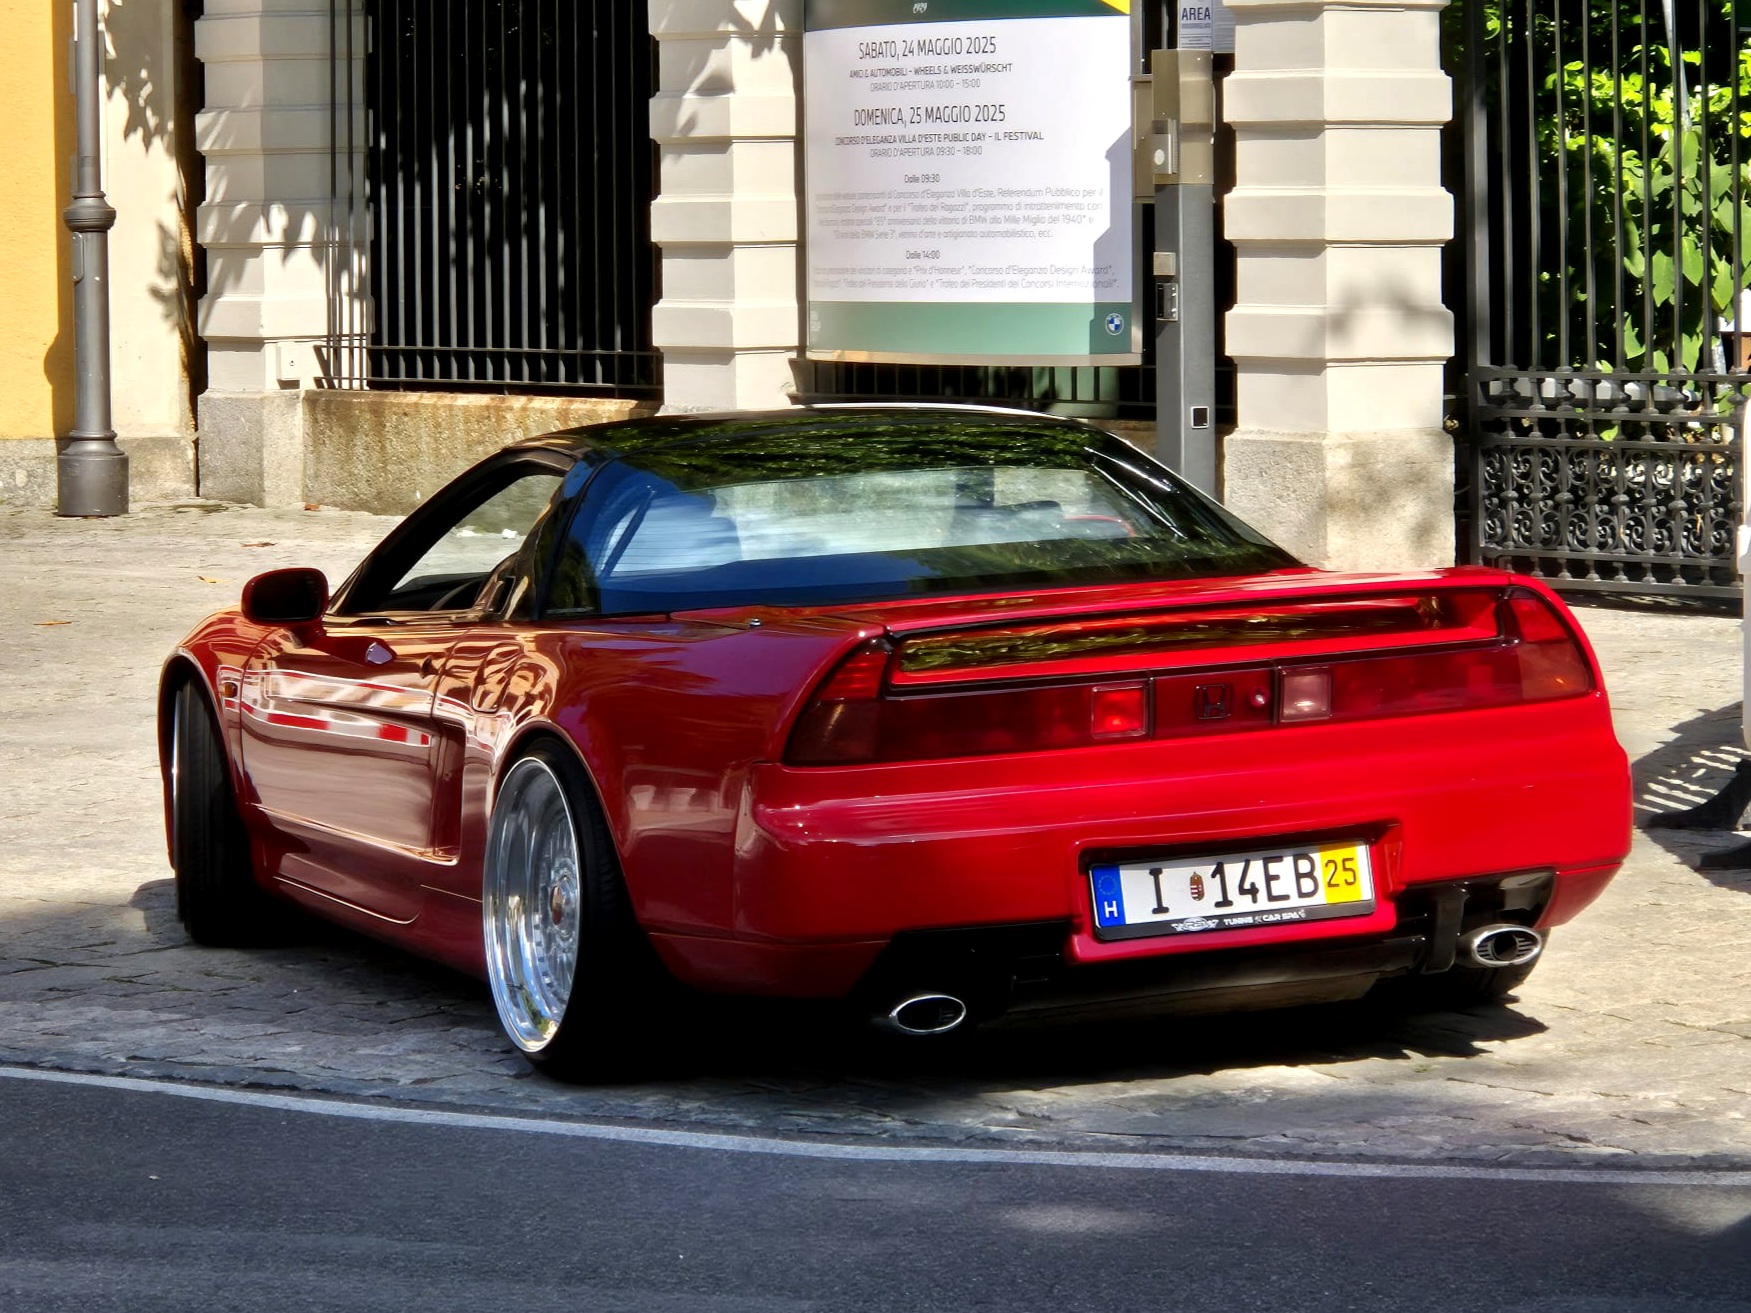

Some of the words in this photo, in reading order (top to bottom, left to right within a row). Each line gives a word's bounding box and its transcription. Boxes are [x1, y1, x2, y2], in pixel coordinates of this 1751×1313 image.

[1181, 7, 1211, 20] AREA
[859, 41, 900, 60] SABATO,
[902, 40, 915, 57] 24
[917, 38, 963, 56] MAGGIO
[966, 36, 996, 54] 2025
[870, 68, 908, 78] AUTOMOBILI
[914, 66, 942, 76] WHEELS
[943, 65, 948, 75] &
[951, 63, 1013, 74] WEISSWÜRSCHT
[870, 82, 892, 92] ORARIO
[936, 79, 955, 89] 10:00
[962, 78, 981, 88] 15:00
[854, 107, 907, 127] DOMENICA,
[909, 107, 922, 123] 25
[925, 105, 971, 123] MAGGIO
[974, 104, 1006, 122] 2025
[899, 134, 917, 144] VILLA
[918, 133, 942, 143] D'ESTE
[944, 133, 970, 142] PUBLIC
[971, 132, 986, 142] DAY
[994, 132, 1001, 141] IL
[1003, 131, 1044, 141] FESTIVAL
[870, 148, 892, 158] ORARIO
[936, 146, 955, 156] 09:30
[904, 174, 920, 183] Dalle
[921, 173, 940, 183] 09:30
[1045, 186, 1080, 197] Pubblico
[1082, 188, 1097, 199] per
[1087, 202, 1103, 211] con
[905, 250, 921, 260] Dalle
[922, 250, 940, 259] 14:00
[1049, 265, 1079, 277] Design
[1211, 854, 1319, 908] 14EB
[1324, 857, 1357, 888] 25
[1104, 900, 1118, 918] H
[1263, 913, 1281, 921] CAR
